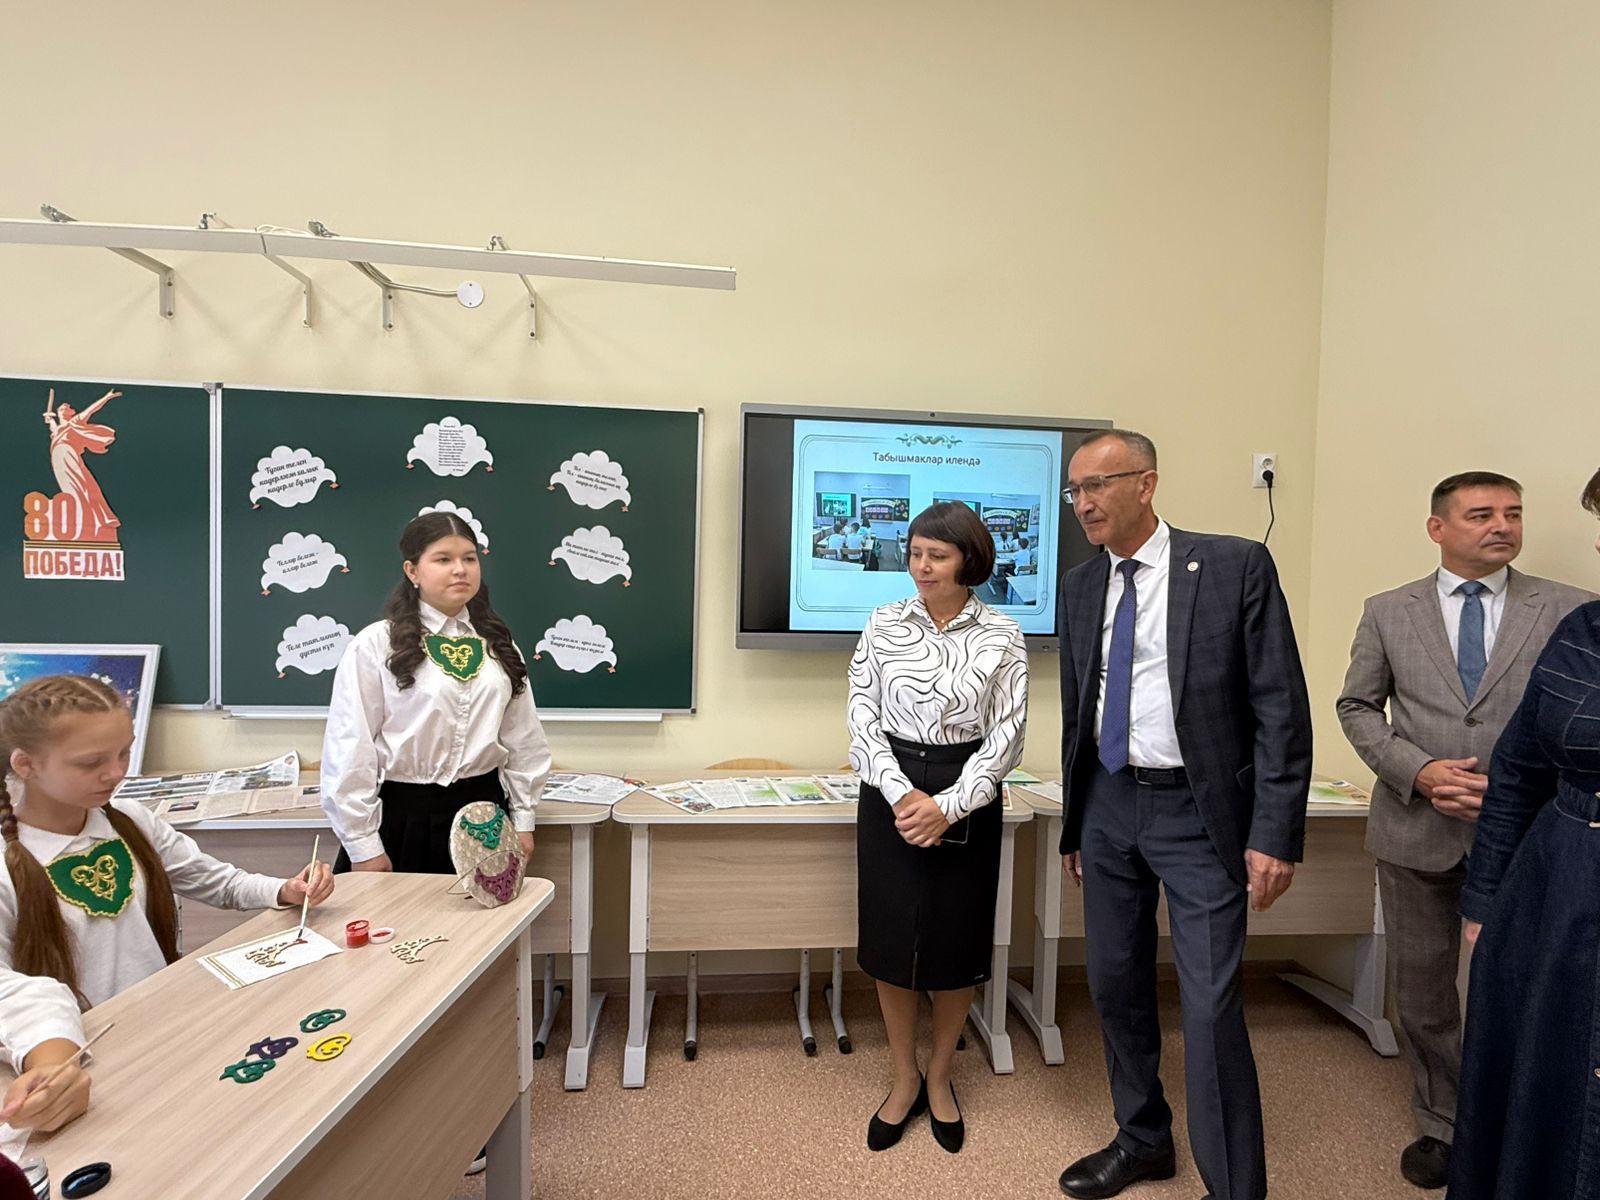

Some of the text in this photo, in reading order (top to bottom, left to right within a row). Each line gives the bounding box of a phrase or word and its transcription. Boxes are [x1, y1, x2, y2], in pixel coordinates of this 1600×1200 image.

[873, 452, 981, 466] Табышмаклар илендә
[265, 465, 285, 475] Туган
[23, 491, 77, 540] 80
[24, 551, 121, 577] ПОБЕДА!
